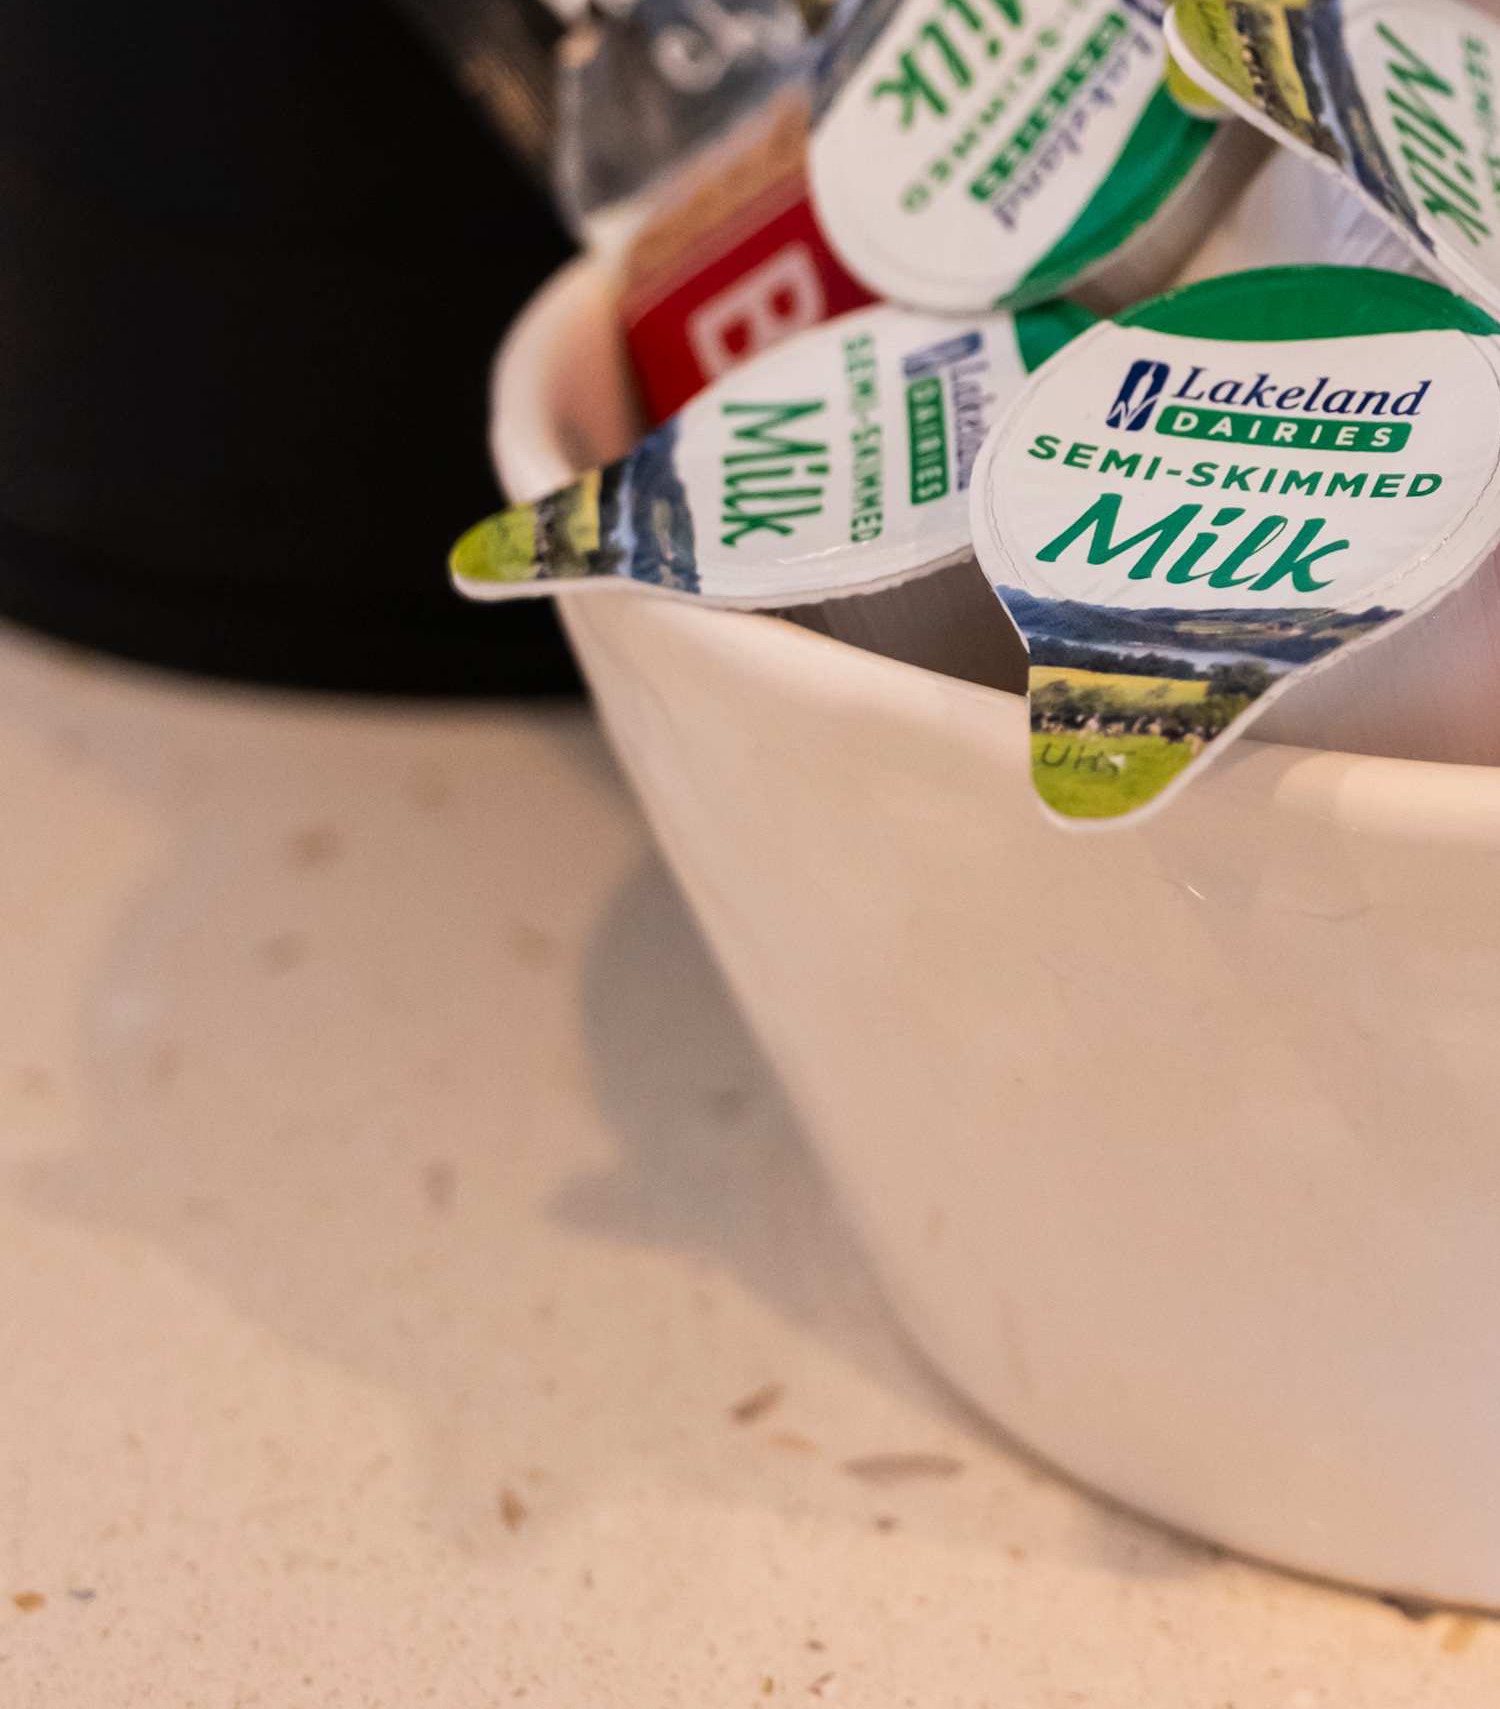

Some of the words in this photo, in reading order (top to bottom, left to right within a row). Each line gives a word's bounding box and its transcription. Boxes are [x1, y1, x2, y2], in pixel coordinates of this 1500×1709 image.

[1375, 22, 1492, 246] Milk
[844, 333, 884, 543] SEMI-SKIMMED
[1170, 365, 1433, 416] Lakeland
[1171, 414, 1394, 448] DAIRIES
[720, 397, 832, 548] Milk
[1027, 434, 1444, 499] SEMI-SKIMMED
[1035, 492, 1351, 592] Milk
